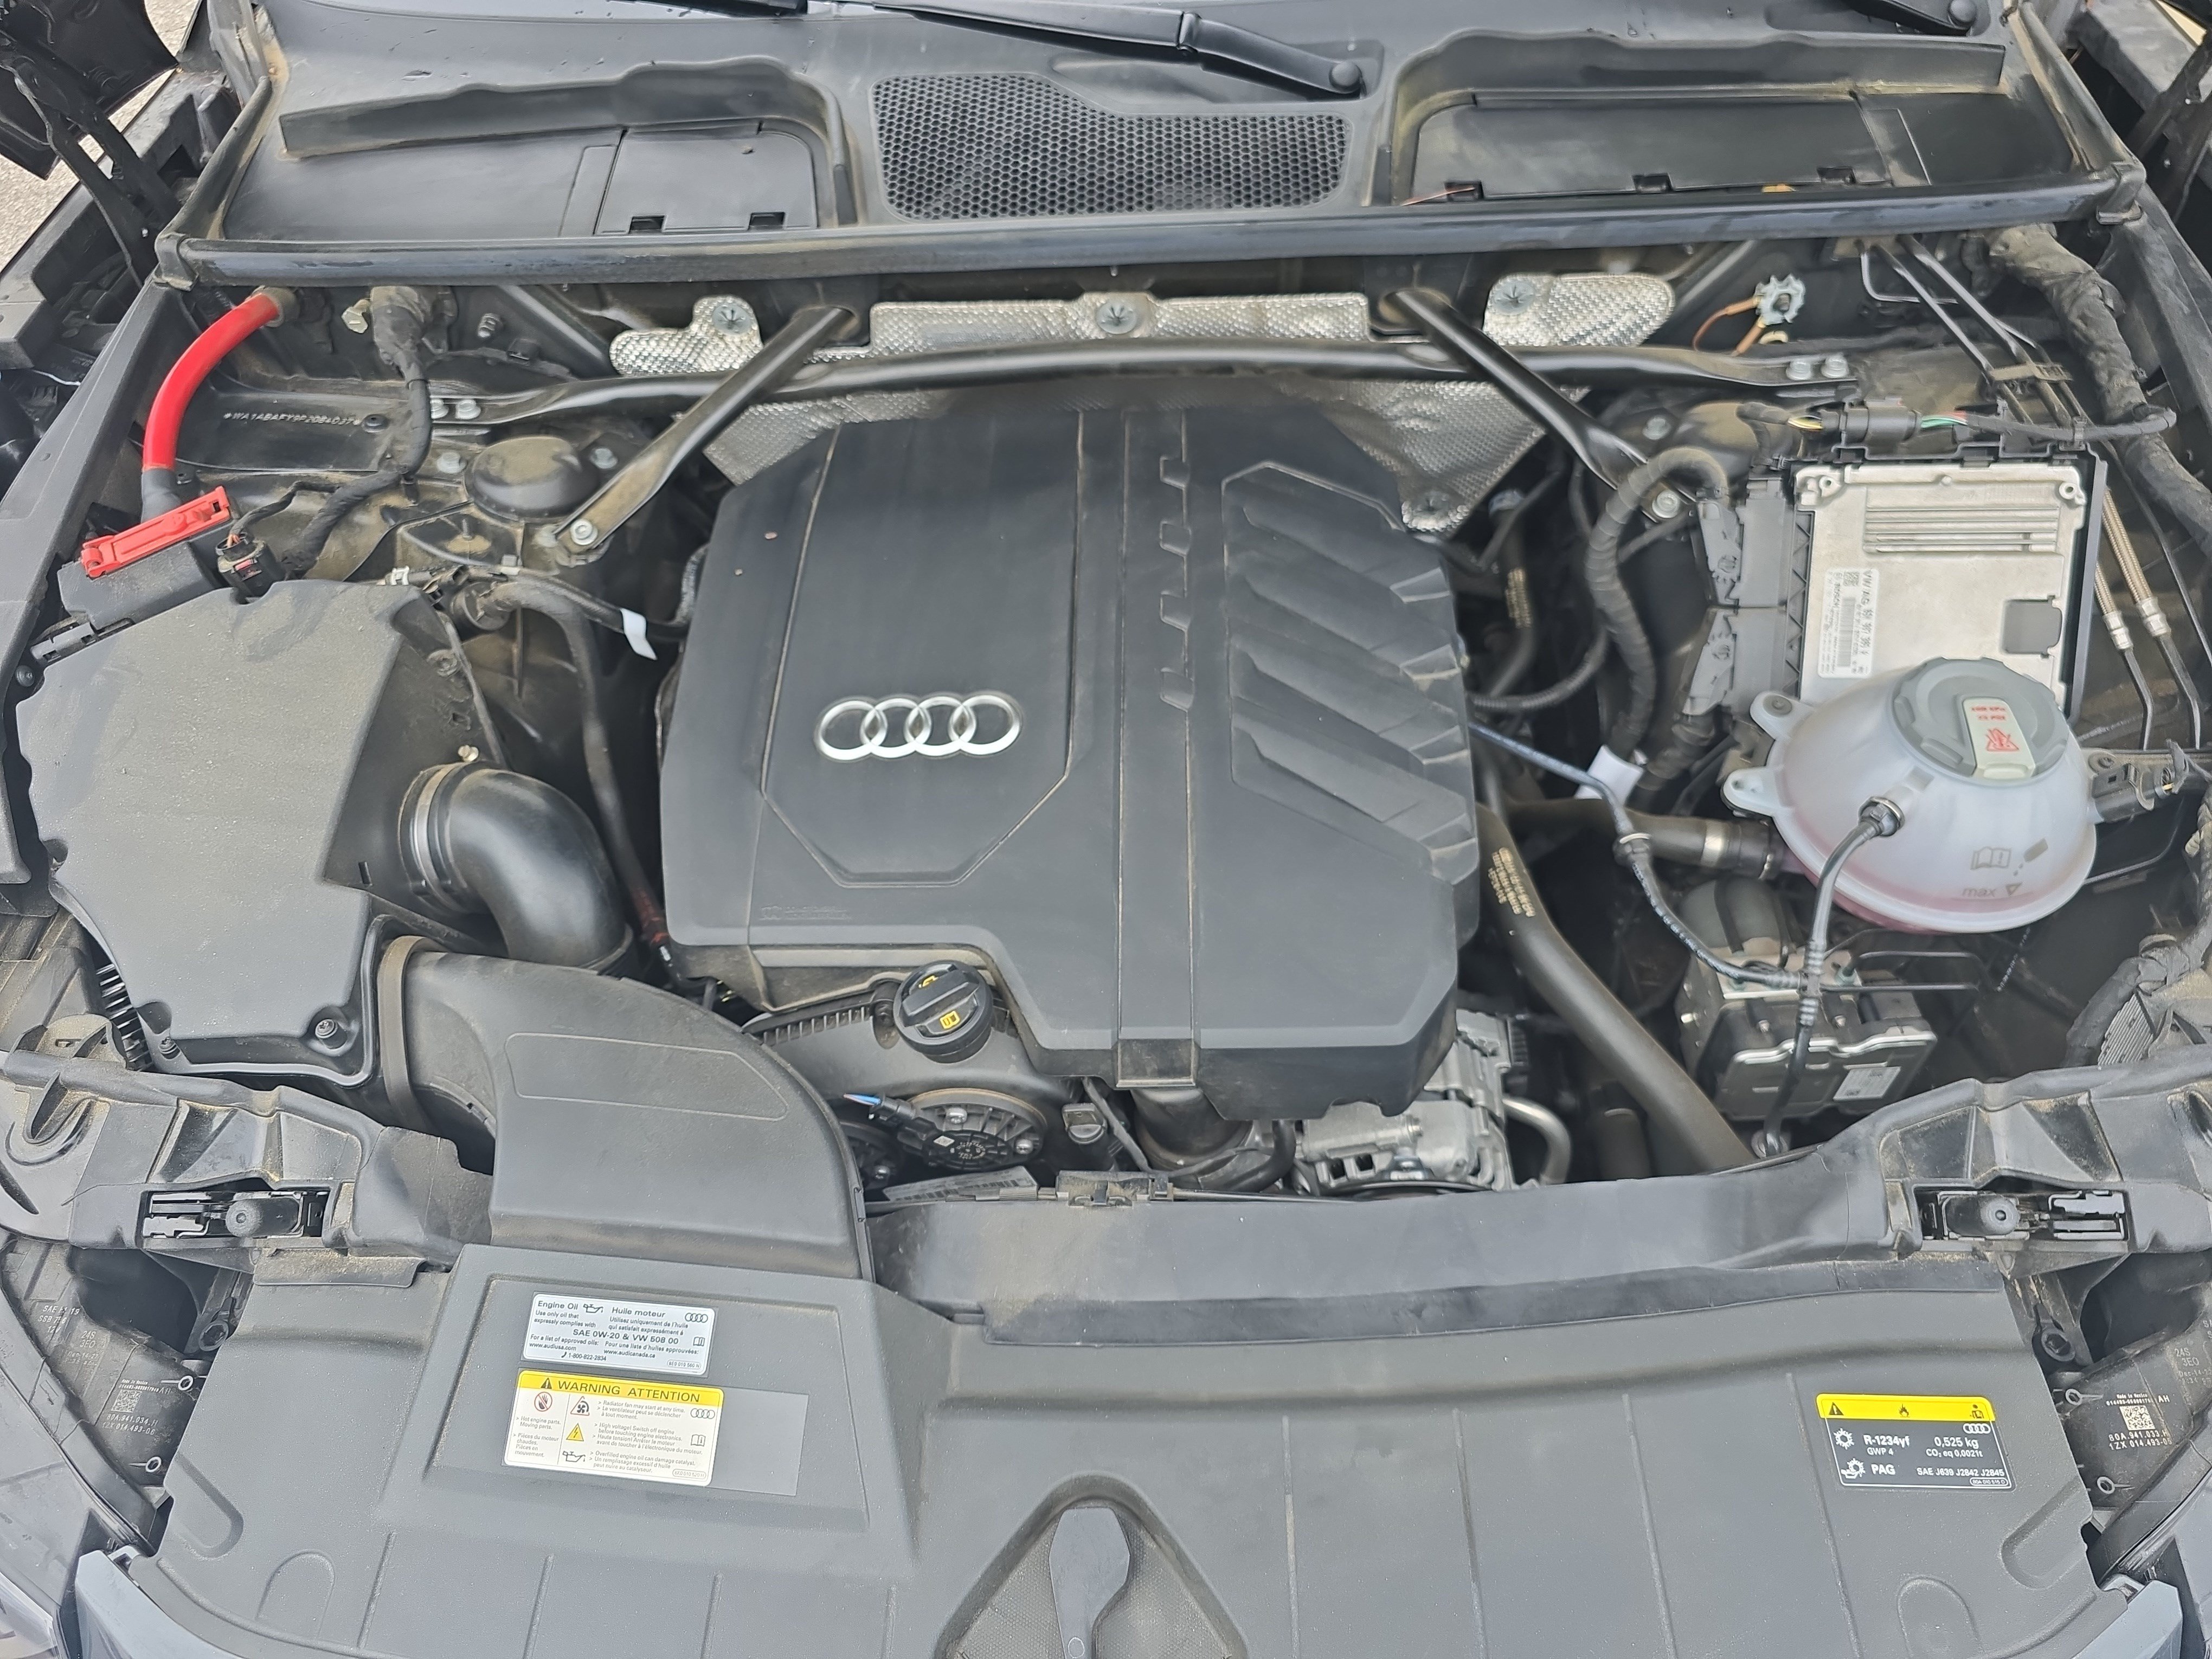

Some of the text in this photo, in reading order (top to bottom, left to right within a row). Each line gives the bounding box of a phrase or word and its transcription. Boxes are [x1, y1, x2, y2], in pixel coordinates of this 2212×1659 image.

[1962, 887, 1996, 898] max
[43, 1305, 58, 1313] SAE
[538, 1301, 564, 1309] Engine
[612, 1307, 632, 1315] Huile
[80, 1330, 96, 1339] 24S
[593, 1330, 620, 1339] 0W-20
[529, 1342, 577, 1351] www.audiusa.com
[569, 1353, 607, 1361] 1-800-822-2834
[603, 1349, 655, 1358] www.audicanada.ca
[2175, 1348, 2190, 1357] 24S
[558, 1380, 700, 1403] WARNING ATTENTION
[2108, 1430, 2168, 1442] 80A.941.033.H
[1863, 1435, 1909, 1448] R-1234yf
[1934, 1436, 1979, 1449] 0,525 kg
[2109, 1438, 2172, 1450] 1ZX 014.493-05
[1867, 1447, 1887, 1456] GWP
[1871, 1464, 1895, 1475] PAG
[1916, 1467, 1934, 1476] SAE
[1935, 1468, 1954, 1476] J639
[1956, 1468, 1979, 1476] J2842
